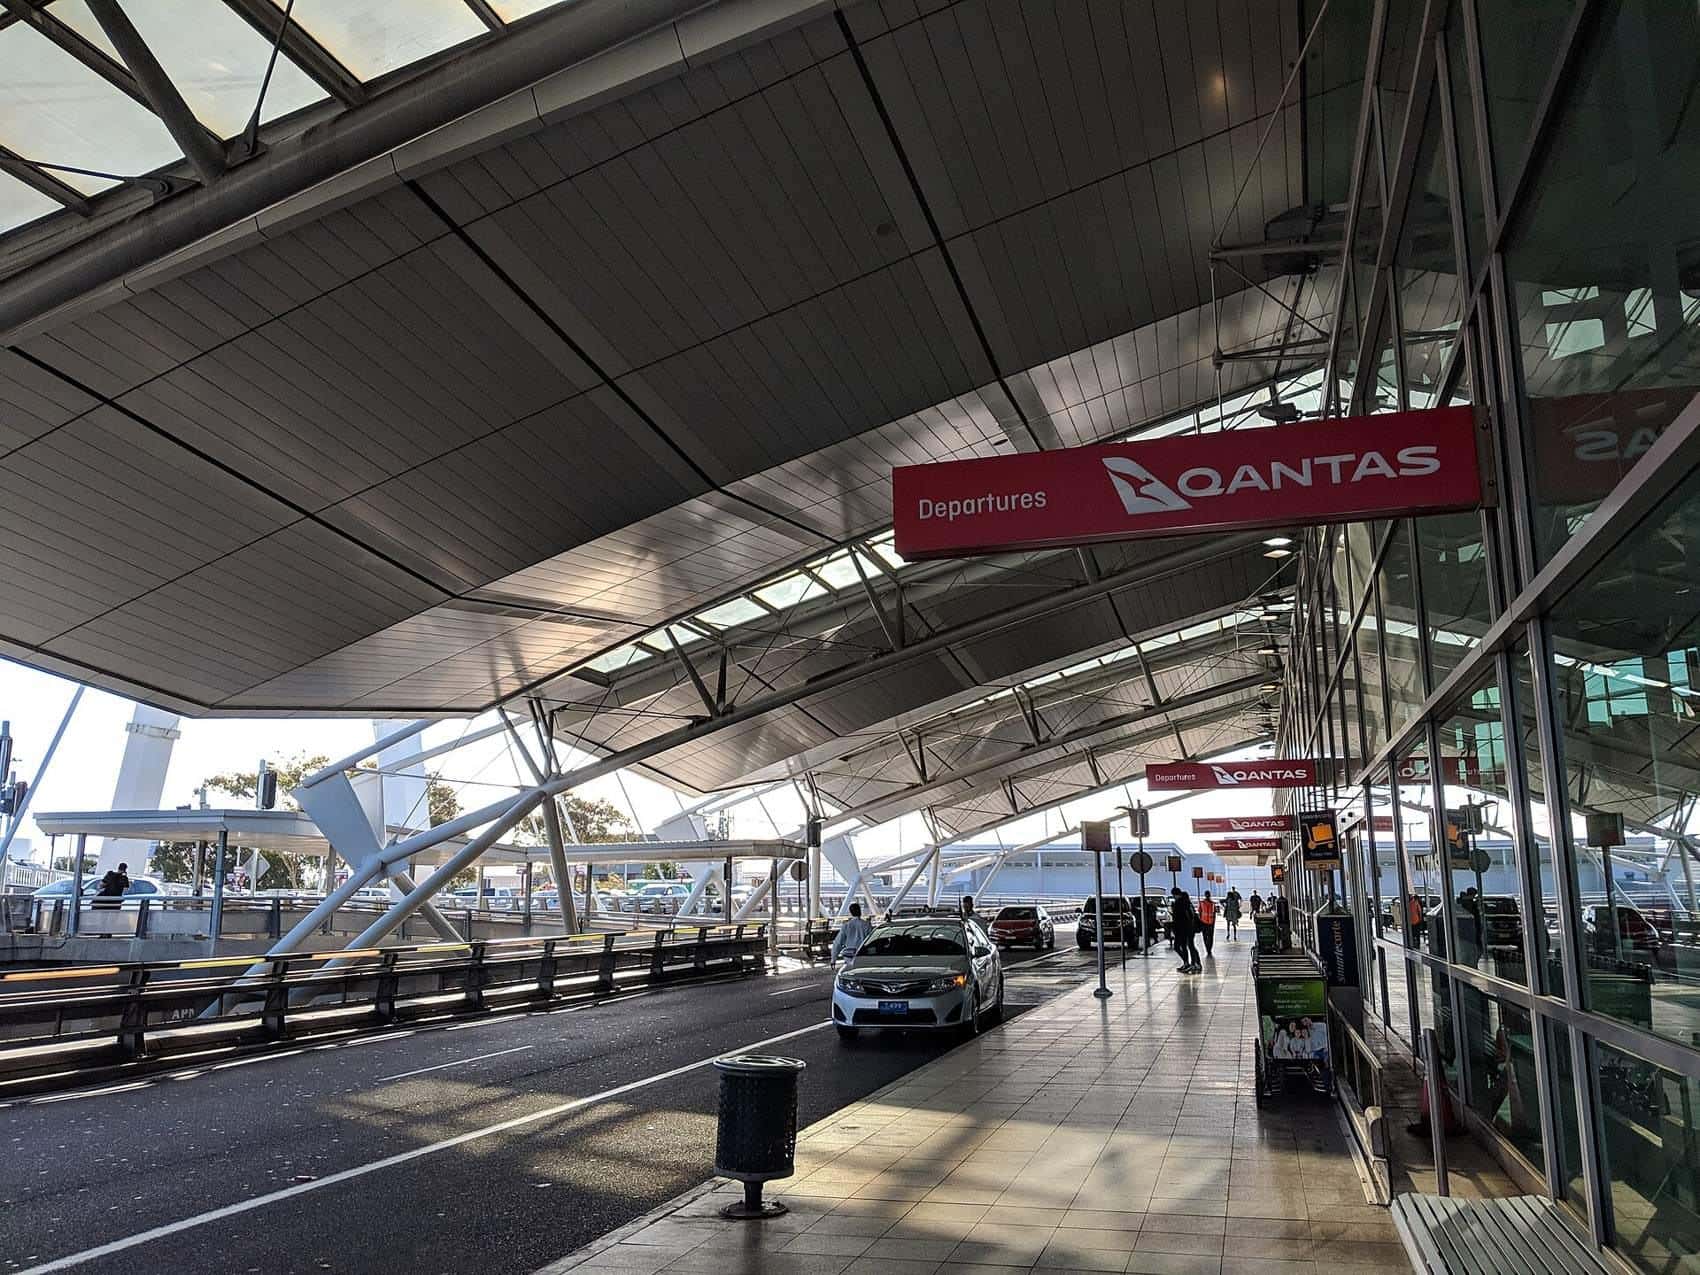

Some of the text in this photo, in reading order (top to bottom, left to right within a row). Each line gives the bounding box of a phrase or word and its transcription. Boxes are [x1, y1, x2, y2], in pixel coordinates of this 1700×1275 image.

[919, 446, 1441, 521] Departures QANTAS
[1155, 769, 1308, 783] Departures QANTAS
[1241, 820, 1285, 828] QANTAS
